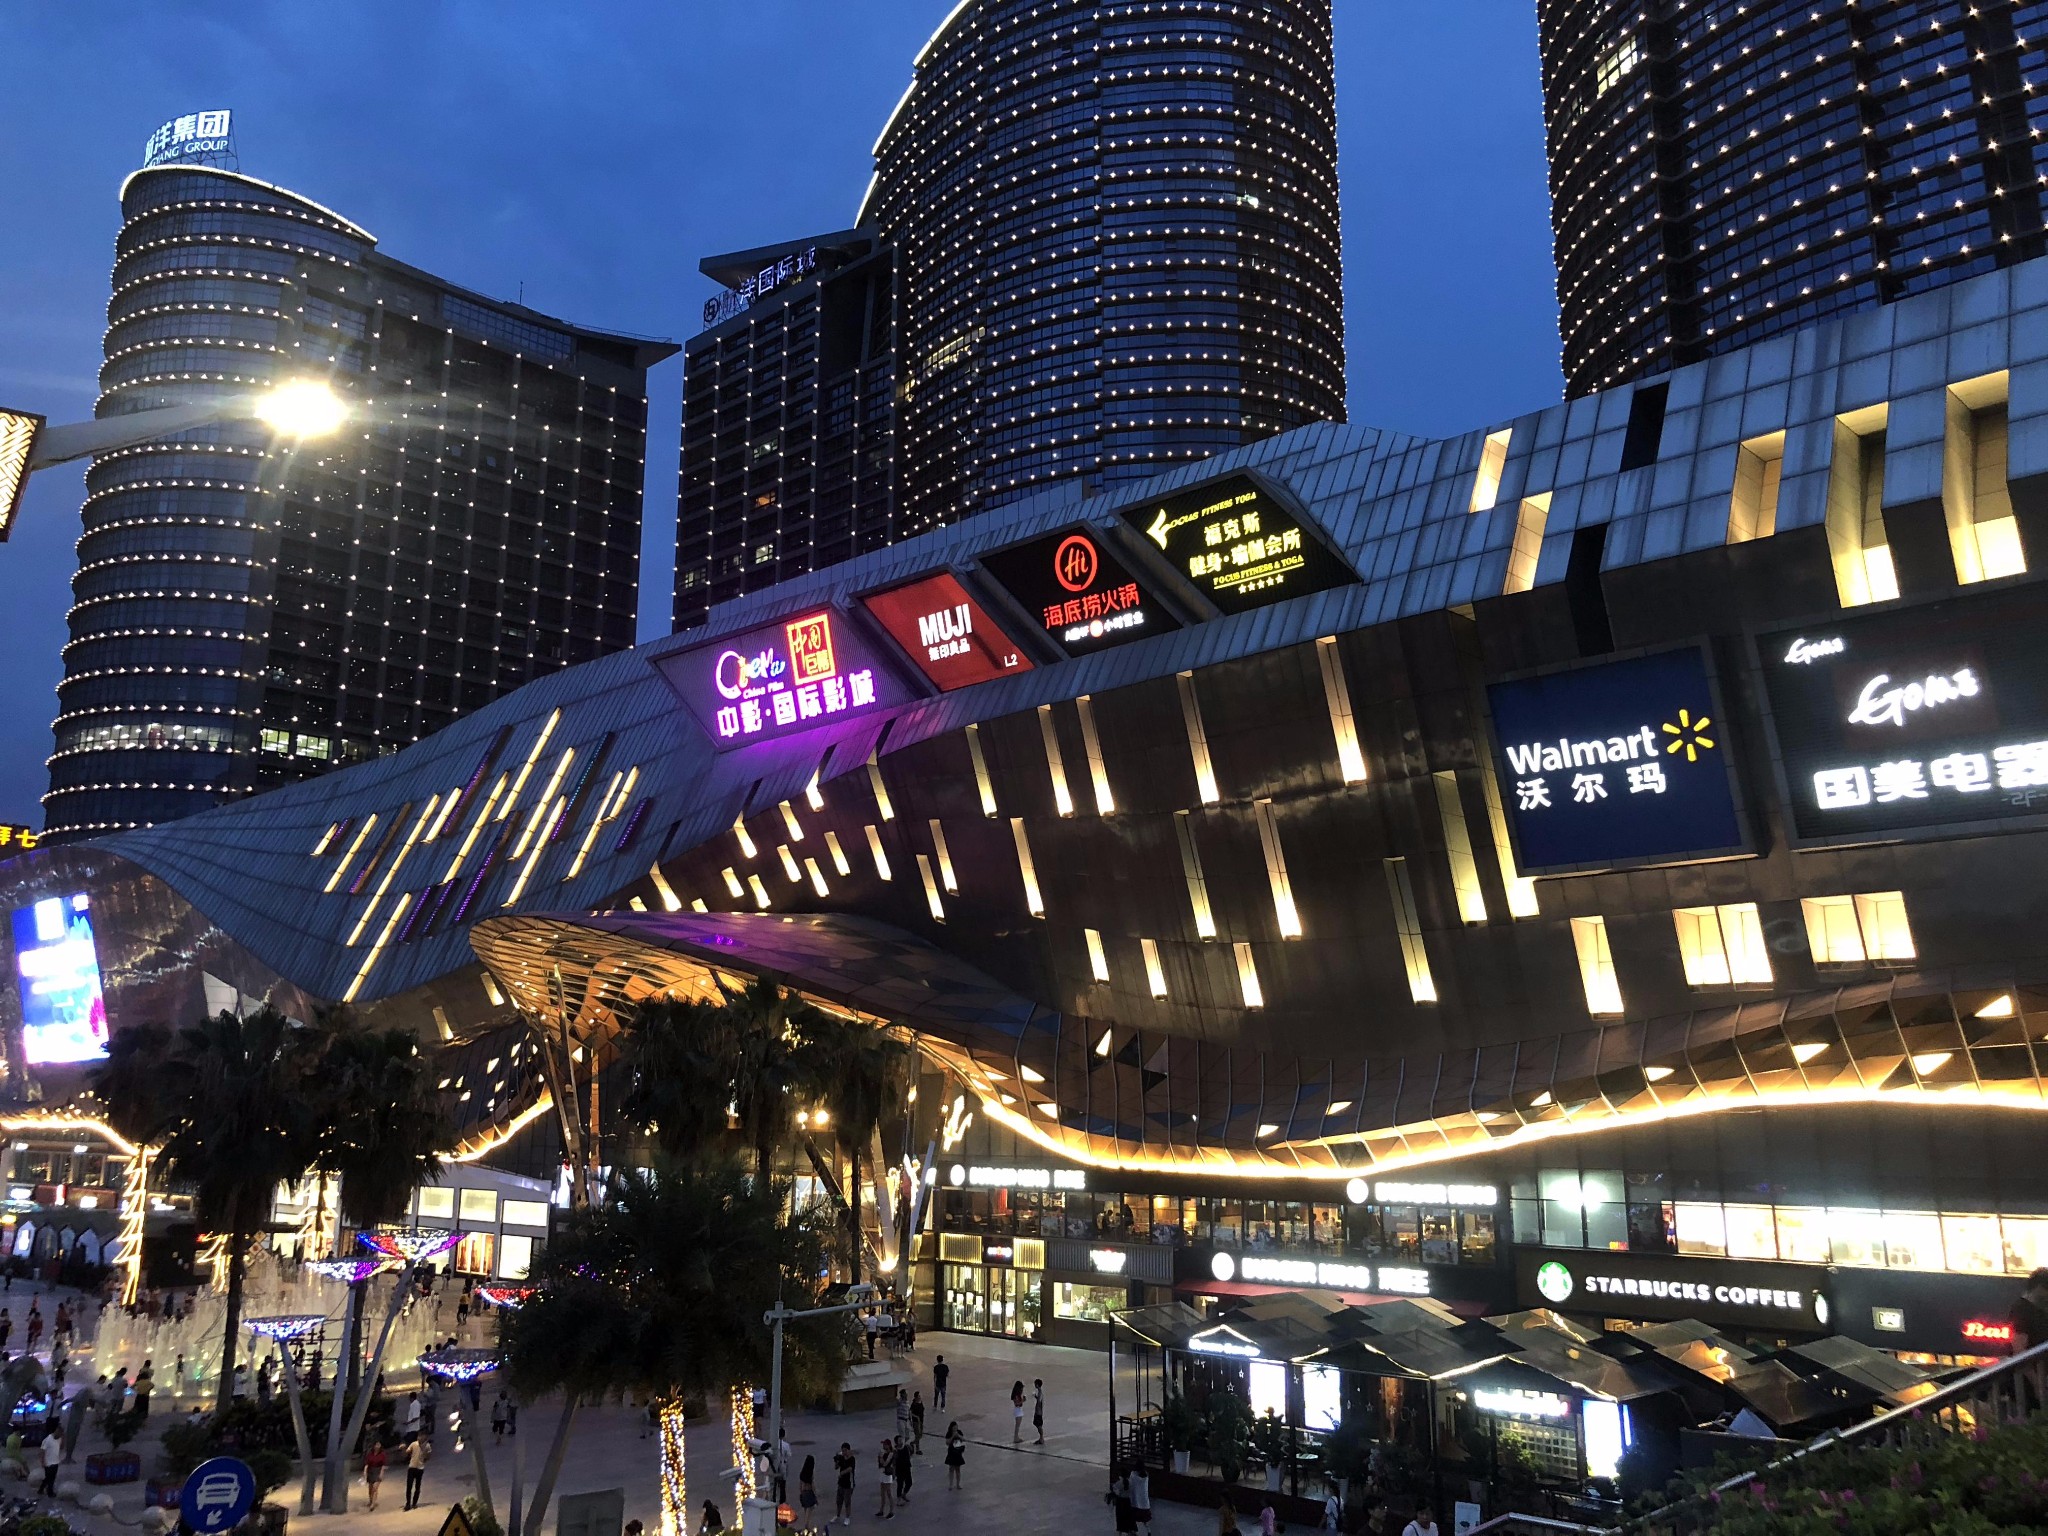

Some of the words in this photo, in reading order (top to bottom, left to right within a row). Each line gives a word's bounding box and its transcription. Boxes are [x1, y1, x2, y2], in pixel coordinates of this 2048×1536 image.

[185, 140, 228, 153] GROUP
[1201, 498, 1233, 517] FITNESS
[1234, 491, 1257, 504] YOGA
[1203, 511, 1260, 547] 福克斯
[1213, 573, 1240, 586] FOCUS
[1240, 563, 1273, 579] FITNESS
[1281, 554, 1304, 567] YOGA
[1043, 582, 1140, 629] 海底捞火锅
[918, 603, 973, 647] MUJI
[1003, 653, 1018, 668] L2
[1506, 725, 1660, 775] Walmart
[1515, 762, 1667, 811] 沃尔玛
[1585, 1275, 1710, 1303] STARBUCKS
[1714, 1284, 1803, 1310] COFFEE
